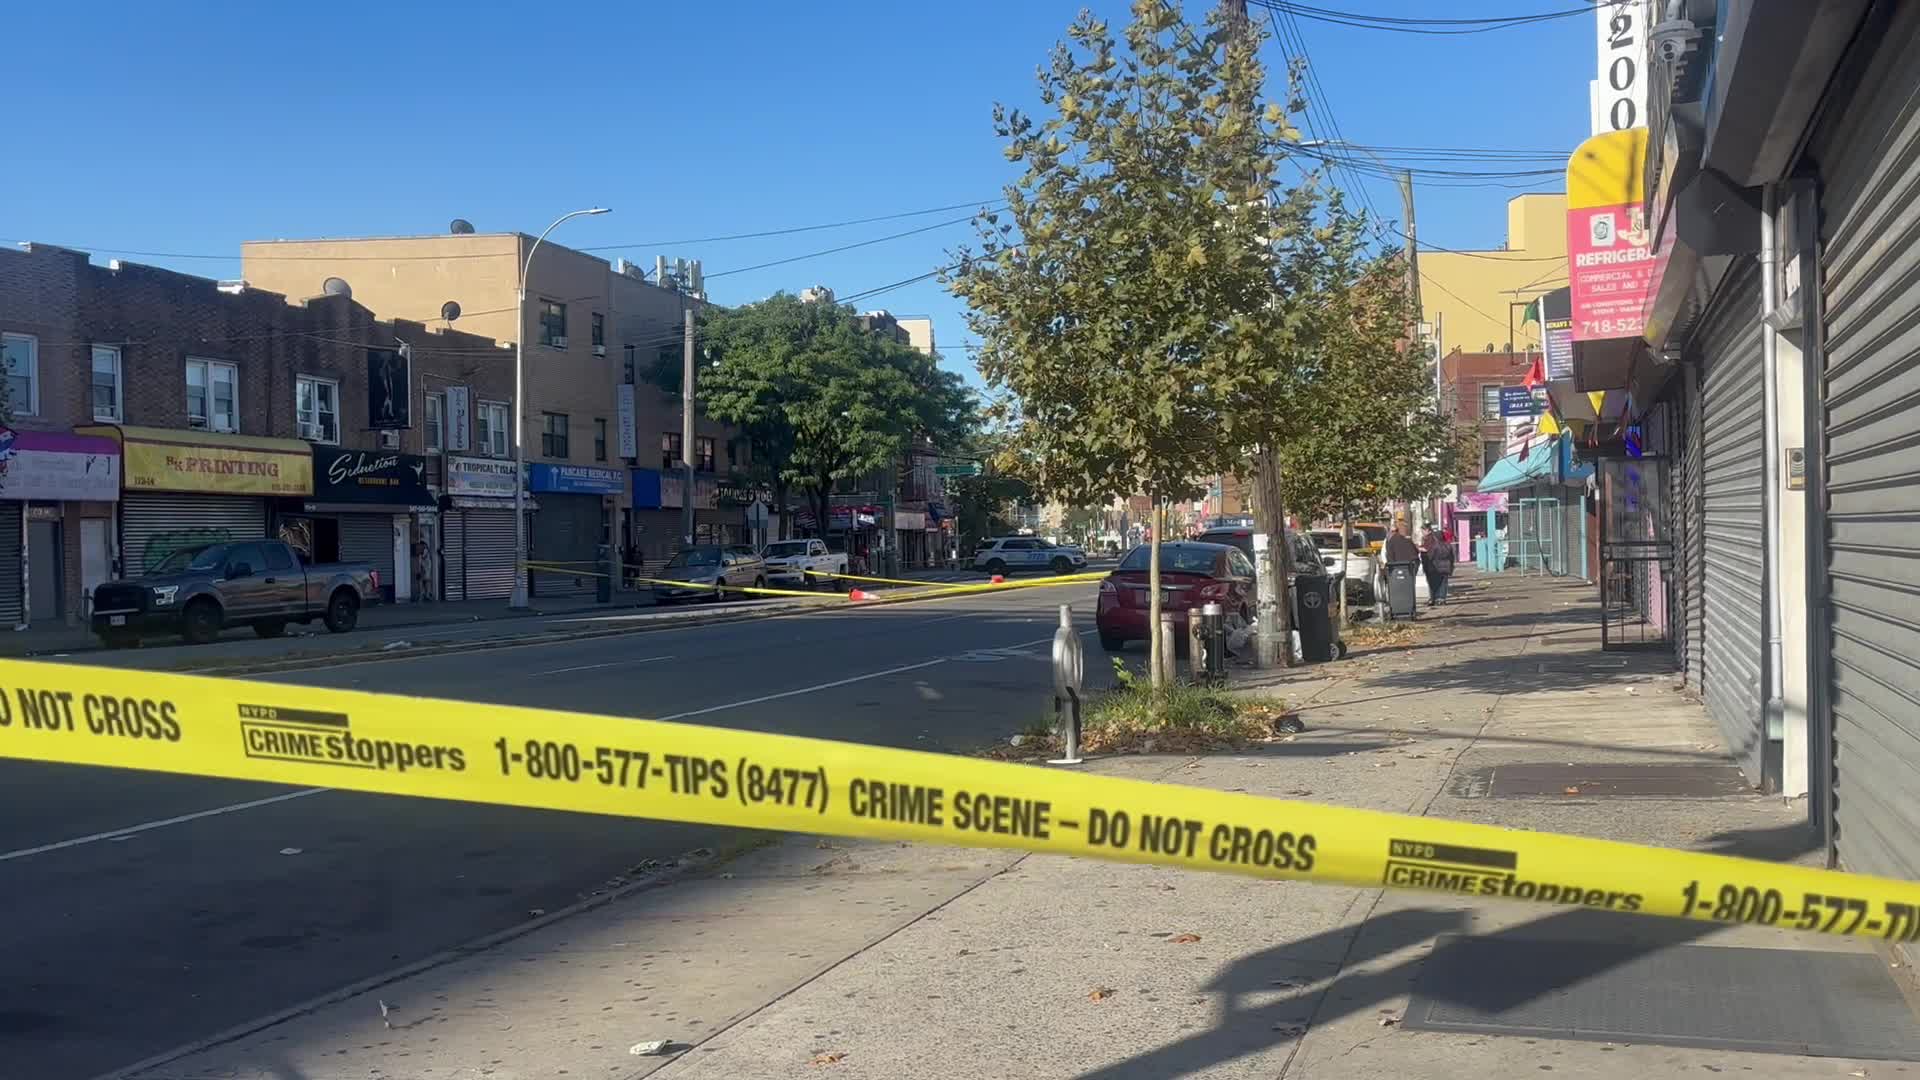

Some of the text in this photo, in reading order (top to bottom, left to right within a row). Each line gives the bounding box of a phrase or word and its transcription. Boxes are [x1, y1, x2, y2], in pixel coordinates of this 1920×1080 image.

[1622, 280, 1639, 289] AND
[186, 457, 280, 478] PRINTING
[328, 452, 399, 485] Seduction
[463, 462, 494, 474] TROPICAL
[16, 688, 75, 732] NOT
[83, 693, 181, 742] CROSS
[240, 706, 277, 719] NYPD
[736, 757, 829, 815] (8477)
[849, 778, 944, 826] CRIME
[953, 791, 1051, 839] SCENE
[1087, 808, 1131, 848] DO
[1139, 815, 1203, 857] NOT
[1209, 823, 1317, 873] CROSS
[1393, 841, 1434, 858] NYPD
[1681, 879, 1920, 943] 1-800-577-TI
